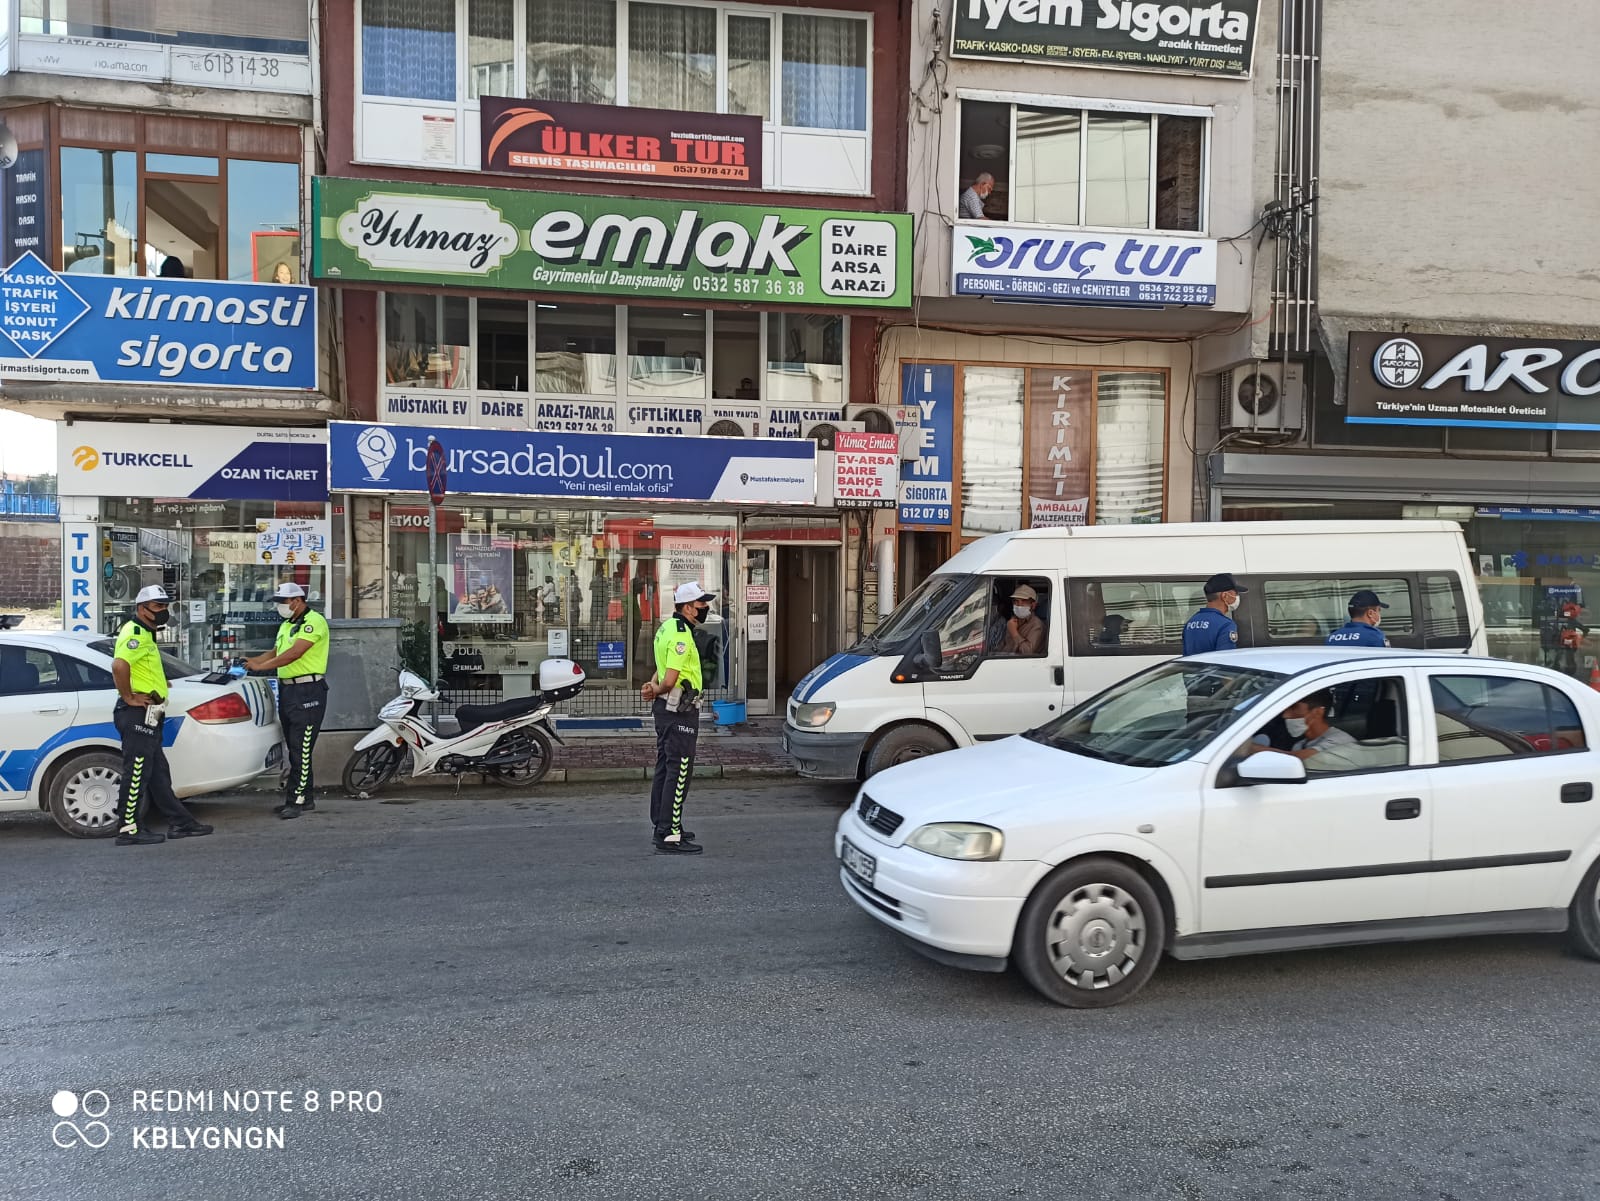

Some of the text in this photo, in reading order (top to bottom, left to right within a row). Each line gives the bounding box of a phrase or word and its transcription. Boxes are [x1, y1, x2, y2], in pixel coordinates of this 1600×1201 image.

[989, 41, 1018, 53] KASKO
[1021, 44, 1044, 54] DASK
[1188, 56, 1210, 68] YURT
[1194, 42, 1243, 54] hizmetleri
[204, 52, 234, 74] 613
[239, 55, 257, 76] 14
[260, 57, 279, 77] 38
[541, 126, 661, 160] ÜLKER
[670, 138, 745, 165] TUR
[673, 165, 698, 173] 0537
[700, 166, 719, 174] 978
[15, 193, 37, 205] KASKO
[18, 215, 35, 225] DASK
[832, 225, 856, 237] EV
[14, 236, 39, 247] YANGIN
[360, 207, 503, 270] Yılmaz
[530, 209, 811, 275] emlak
[1114, 238, 1202, 277] tur
[831, 261, 882, 274] ARSA
[3, 273, 57, 286] KASKO
[533, 266, 805, 296] Gayrimenkul Danışmanlığı 0532 587 36 38
[963, 278, 1005, 292] PERSONEL
[1071, 285, 1081, 295] ve
[1139, 284, 1162, 292] 0536
[1163, 285, 1181, 293] 292
[1196, 286, 1208, 294] 48
[1, 287, 59, 300] TRAFİK
[1139, 293, 1162, 301] 0531
[1163, 293, 1181, 301] 742
[1196, 294, 1208, 302] 87
[5, 299, 56, 314] İŞYERİ
[104, 286, 308, 327] kirmasti
[4, 315, 58, 327] KONUT
[11, 329, 53, 341] DASK
[117, 334, 294, 377] sigorta
[452, 401, 468, 415] EV
[1376, 401, 1547, 415] Türkiye'nin Uzman Motosiklet Üreticisi
[769, 409, 800, 424] ALIM
[838, 434, 896, 451] Yılmaz Emlak
[102, 451, 193, 468] TURKCELL
[837, 455, 895, 466] EV-ARSA
[221, 466, 319, 481] OZAN TİCARET
[588, 481, 612, 492] nesil
[614, 482, 645, 493] emlak
[837, 477, 883, 488] BAHÇE
[838, 487, 882, 498] TARLA
[905, 484, 948, 501] SİGORTA
[902, 507, 949, 519] 612 07 99
[1036, 502, 1083, 513] AMBALAJ
